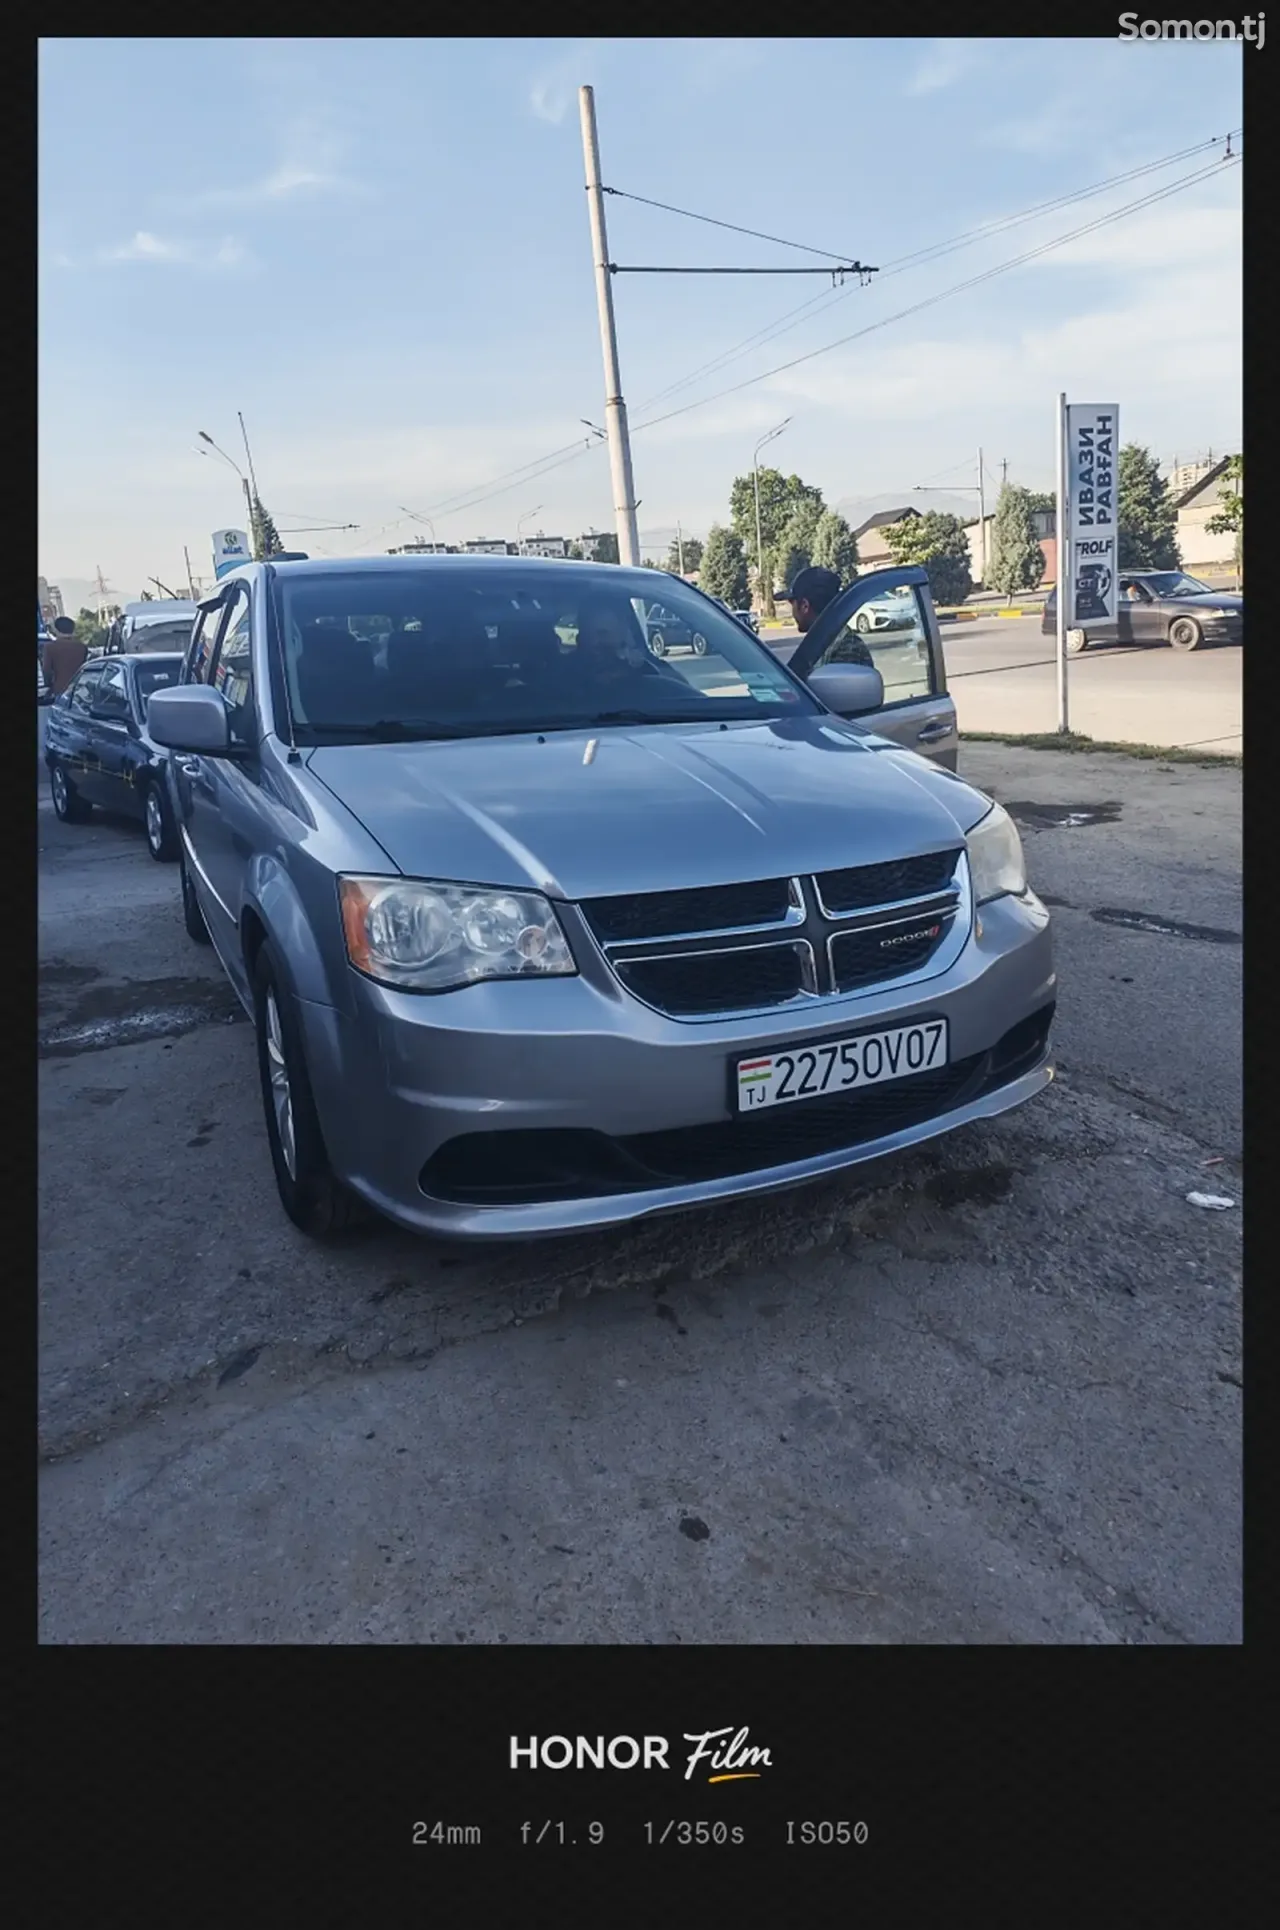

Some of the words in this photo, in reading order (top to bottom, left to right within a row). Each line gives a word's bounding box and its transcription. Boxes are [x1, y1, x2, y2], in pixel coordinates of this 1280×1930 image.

[1078, 428, 1094, 526] ИВАЗИ
[1096, 415, 1113, 525] РАВҒАН
[1080, 540, 1112, 555] ROLF
[746, 1086, 767, 1105] TJ
